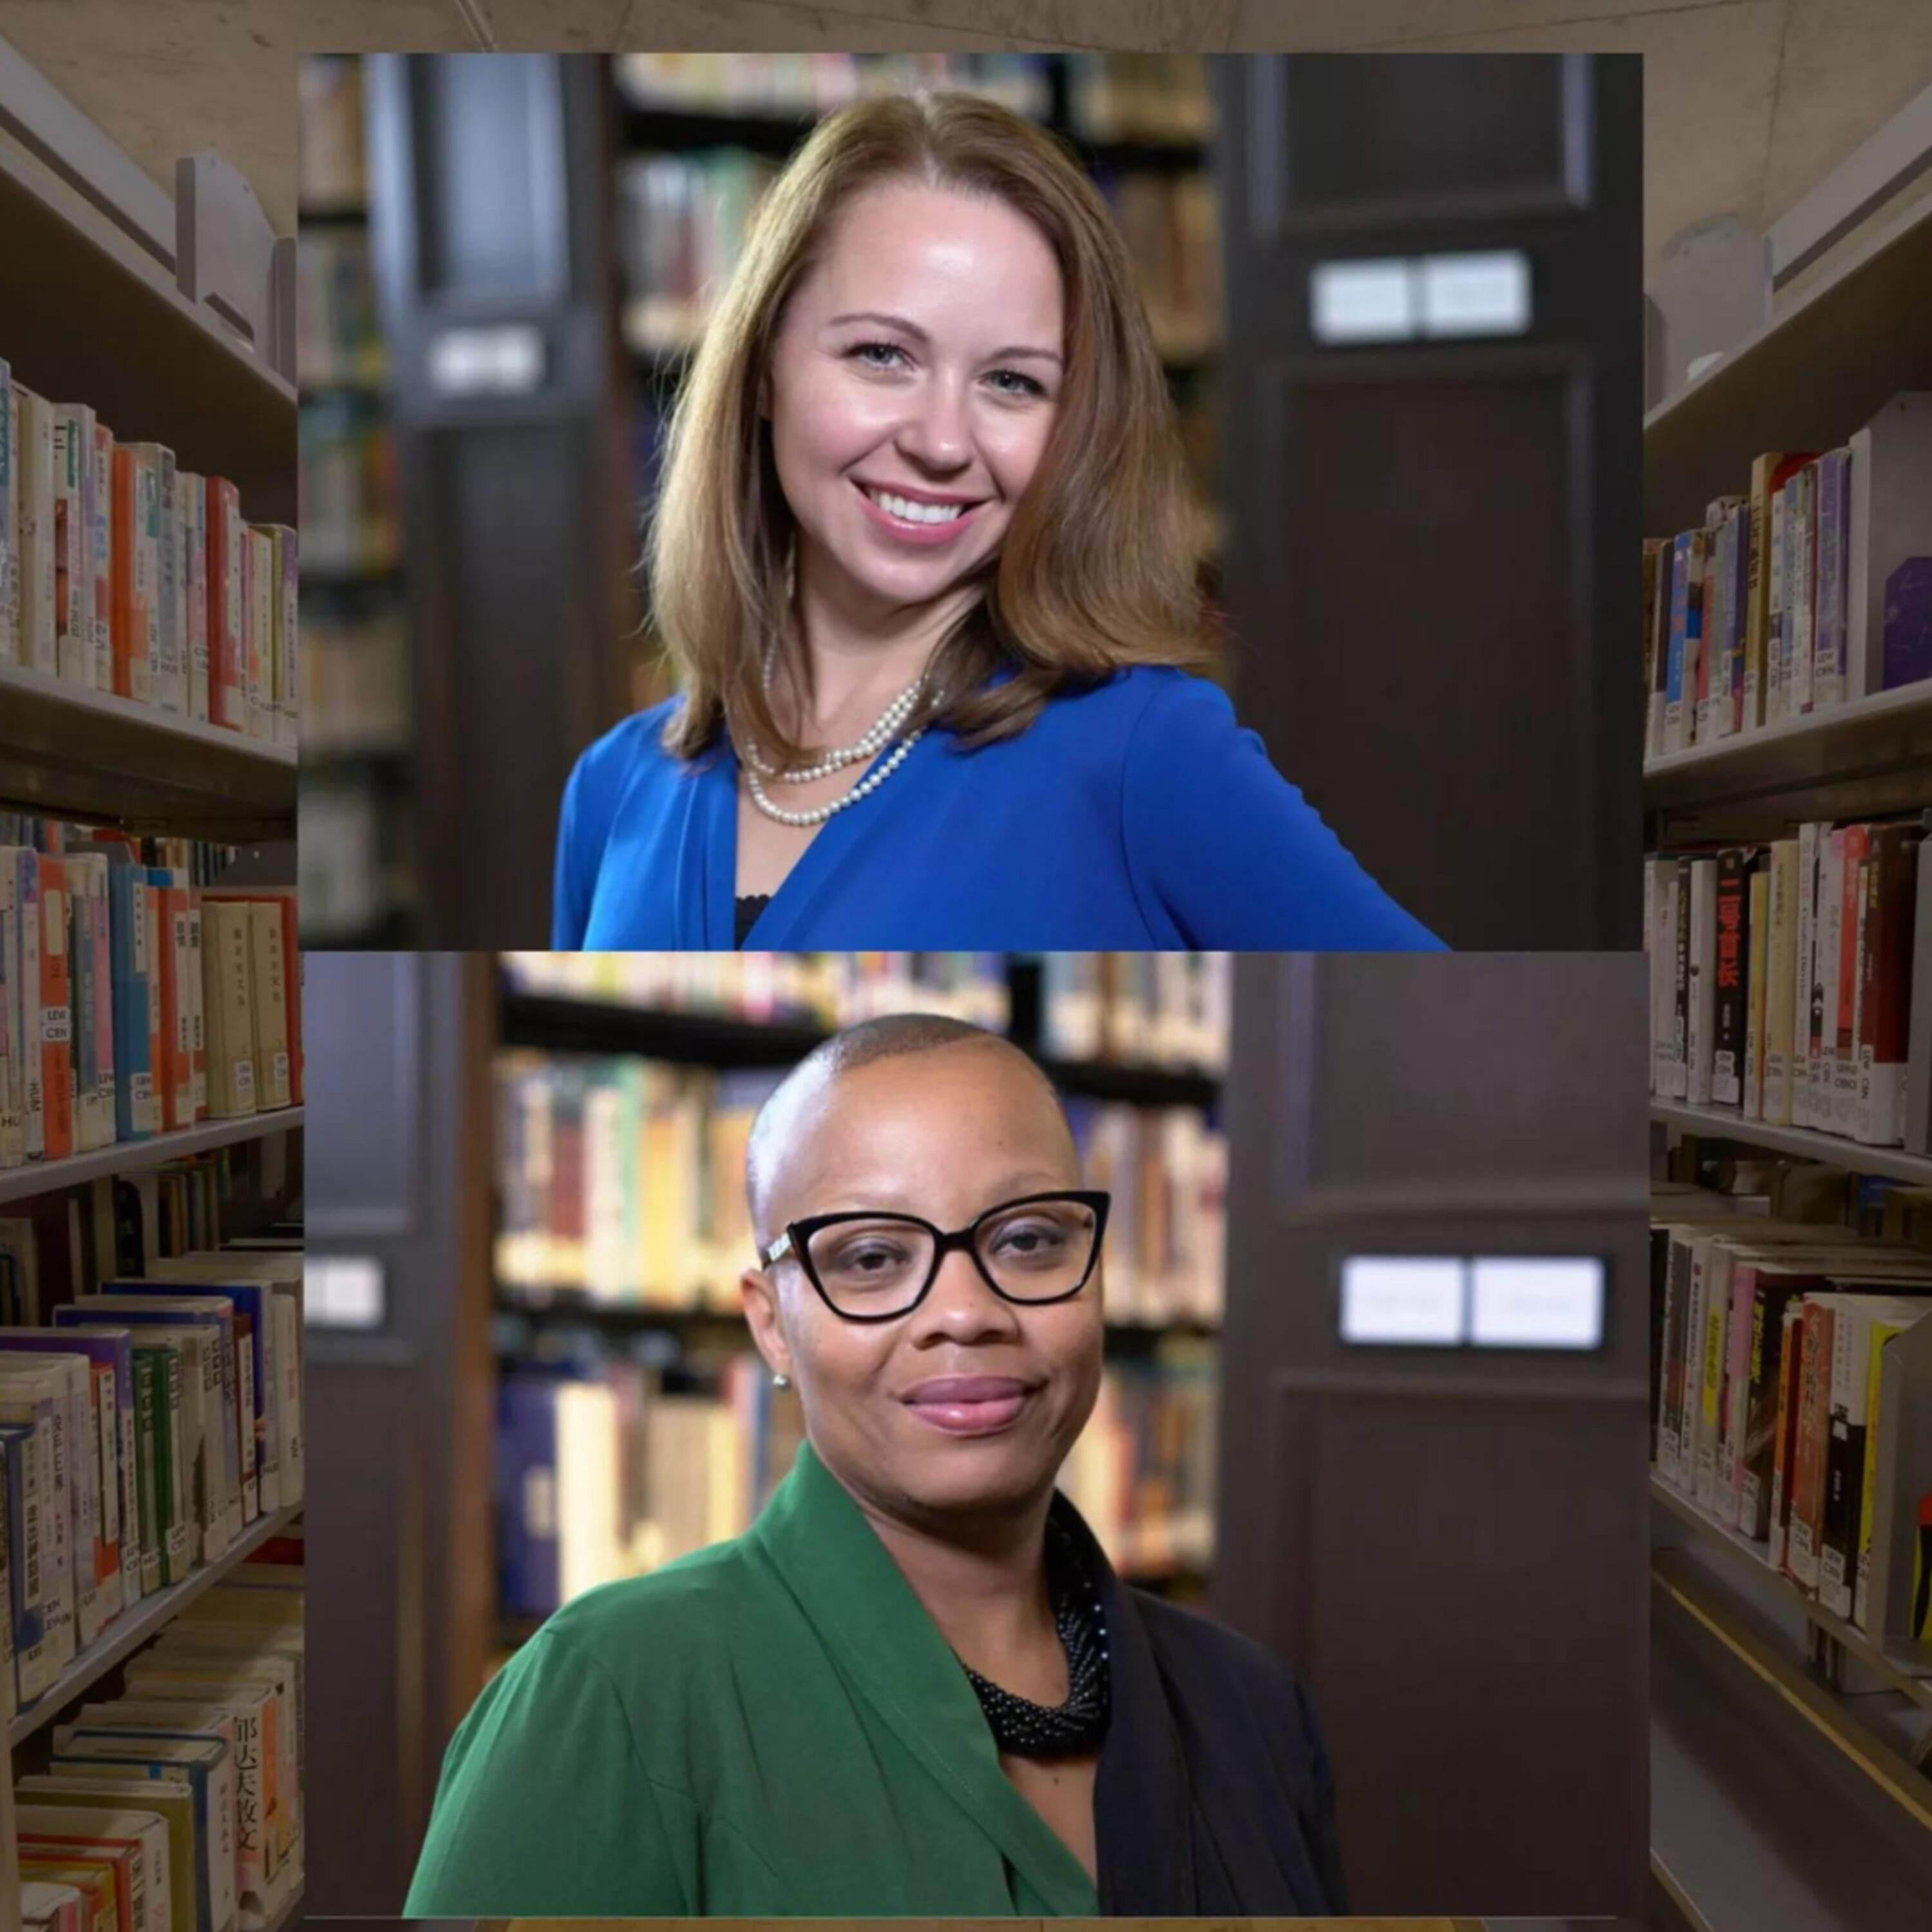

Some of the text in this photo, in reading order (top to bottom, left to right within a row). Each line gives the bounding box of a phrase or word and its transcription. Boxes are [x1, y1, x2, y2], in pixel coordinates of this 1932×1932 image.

[1817, 651, 1833, 663] LEW
[47, 1010, 66, 1021] LEW
[46, 1027, 67, 1038] CEN
[1861, 1049, 1871, 1100] LEW CEN
[29, 1082, 42, 1112] HUM
